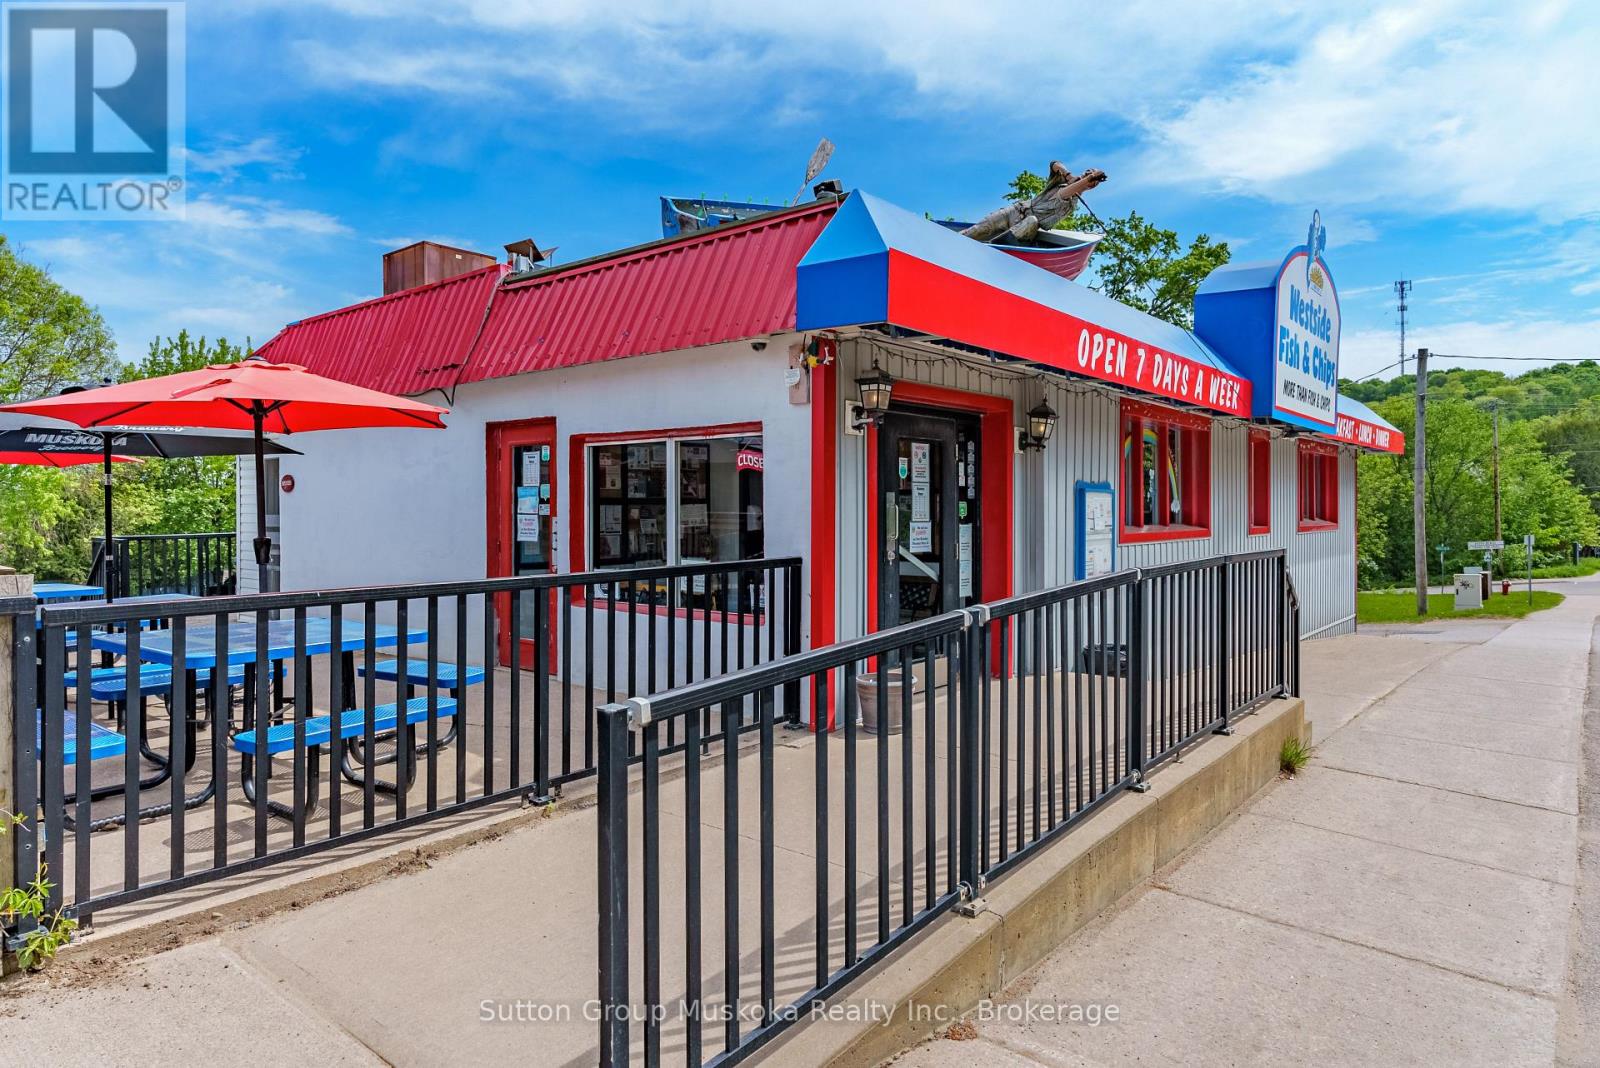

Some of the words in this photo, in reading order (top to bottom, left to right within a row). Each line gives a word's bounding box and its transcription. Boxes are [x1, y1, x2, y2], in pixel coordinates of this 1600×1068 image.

[1289, 284, 1331, 344] Westside
[1077, 328, 1128, 378] OPEN
[1136, 348, 1146, 383] 7
[1152, 353, 1189, 396] DAYS
[1194, 369, 1203, 401] A
[1209, 373, 1240, 410] WEEK
[1279, 324, 1300, 370] Fish
[1302, 340, 1310, 375] &
[1312, 345, 1336, 391] Chips
[1283, 378, 1296, 398] MORE
[1296, 384, 1307, 403] THAN
[24, 433, 127, 446] MUSKOA
[1336, 416, 1355, 441] AKFAST
[737, 453, 763, 469] CLOSE
